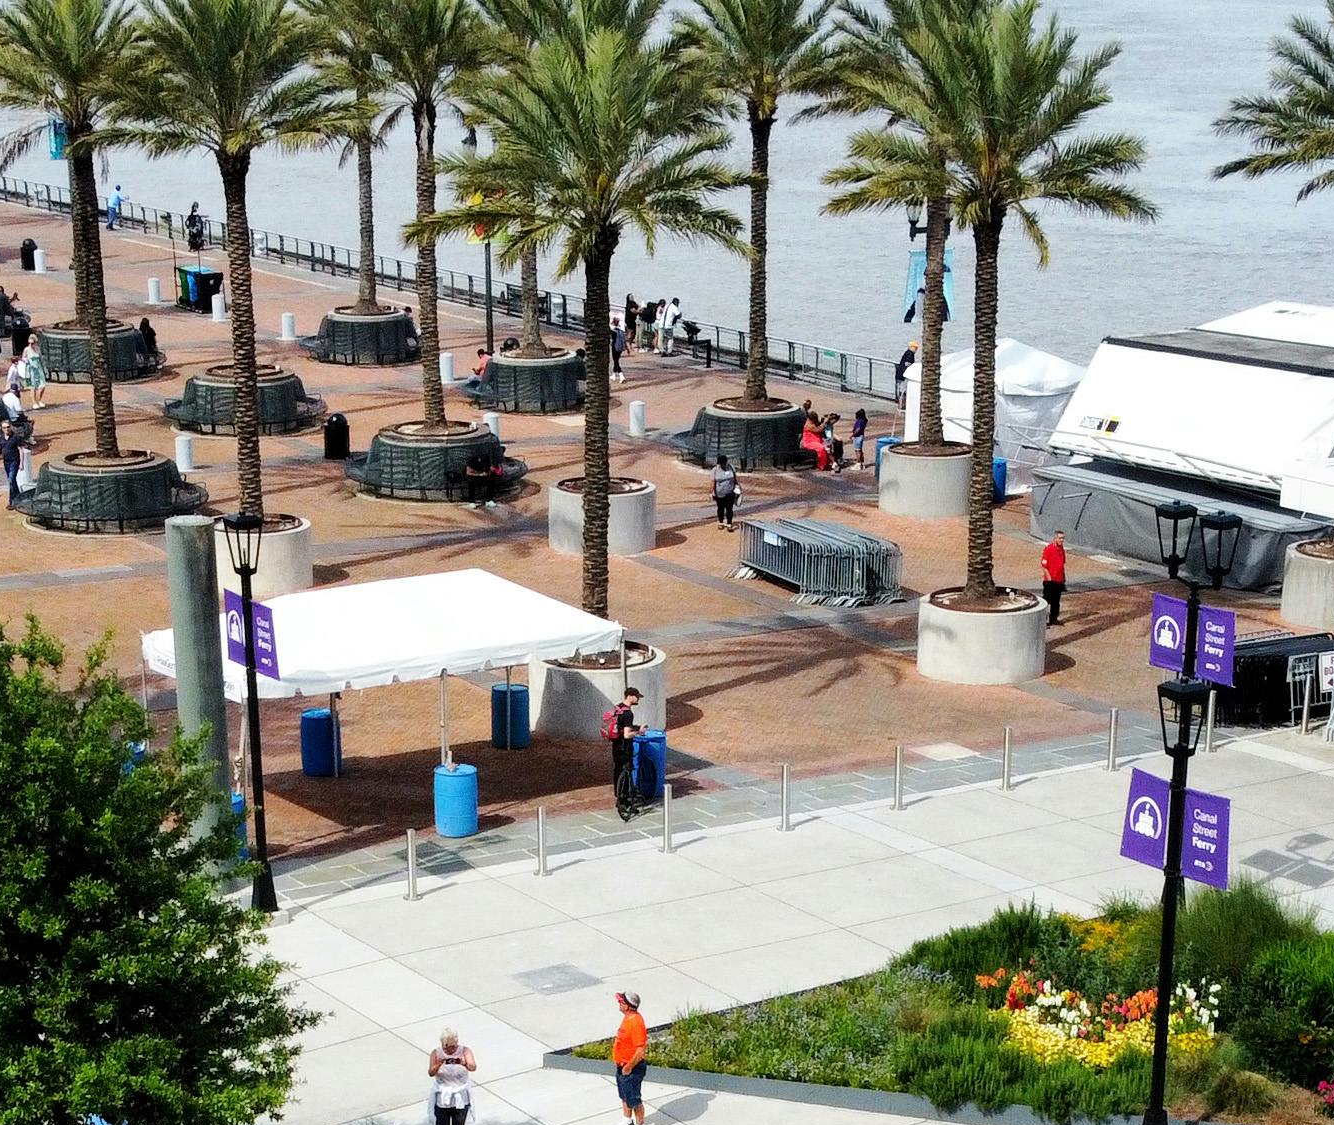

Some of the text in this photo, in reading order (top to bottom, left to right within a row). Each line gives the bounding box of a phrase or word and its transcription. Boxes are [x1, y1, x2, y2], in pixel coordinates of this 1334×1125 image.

[1194, 809, 1217, 824] Canal
[1192, 823, 1217, 838] Street
[1192, 836, 1216, 853] Ferry
